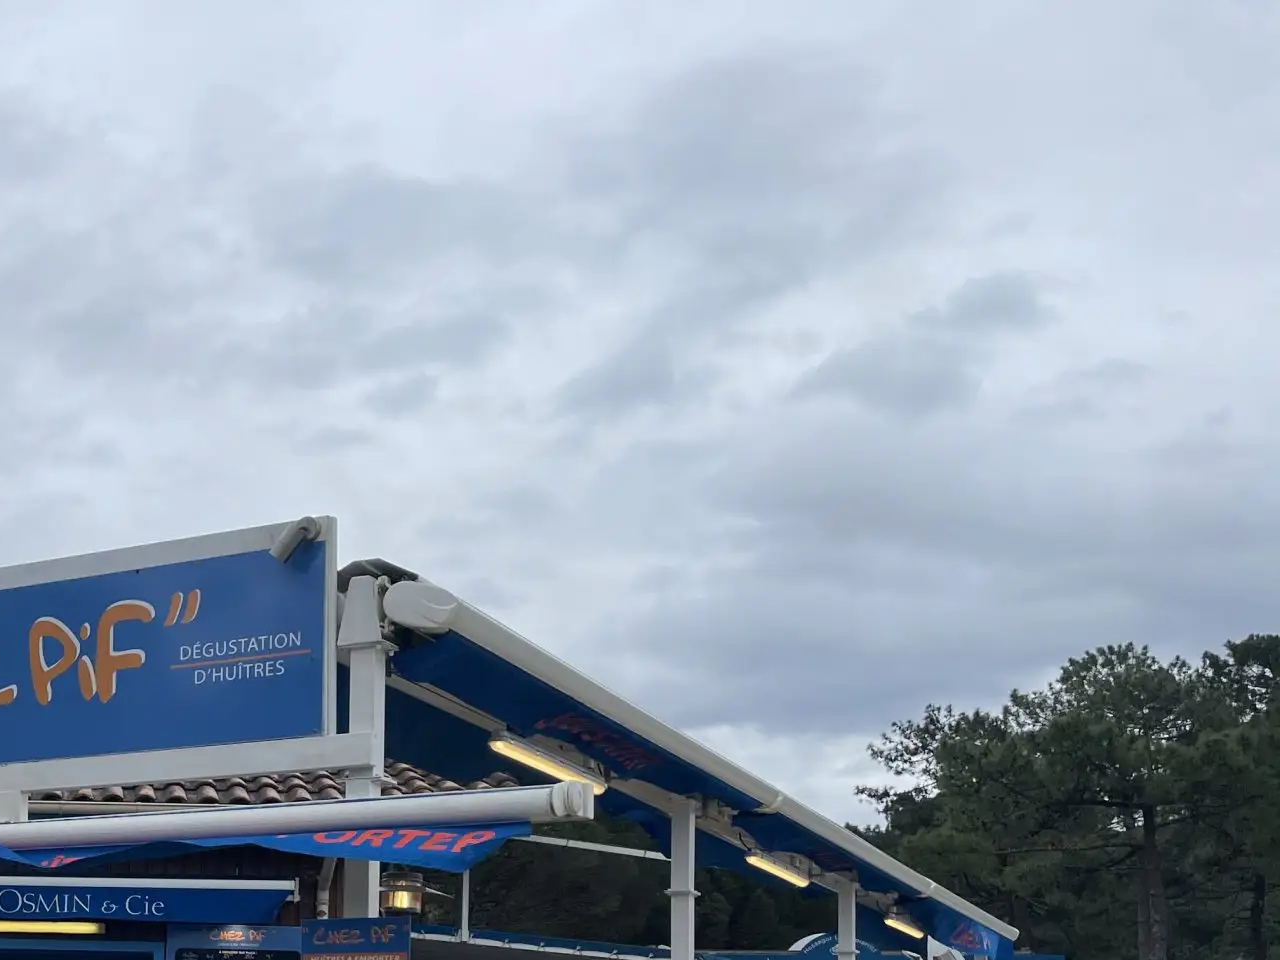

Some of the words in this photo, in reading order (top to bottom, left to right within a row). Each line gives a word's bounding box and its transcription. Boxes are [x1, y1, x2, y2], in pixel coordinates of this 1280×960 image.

[179, 631, 302, 661] DÉGUSTATION
[193, 660, 285, 685] D'HUÎTRES
[101, 899, 119, 914] &
[125, 894, 166, 916] Cie
